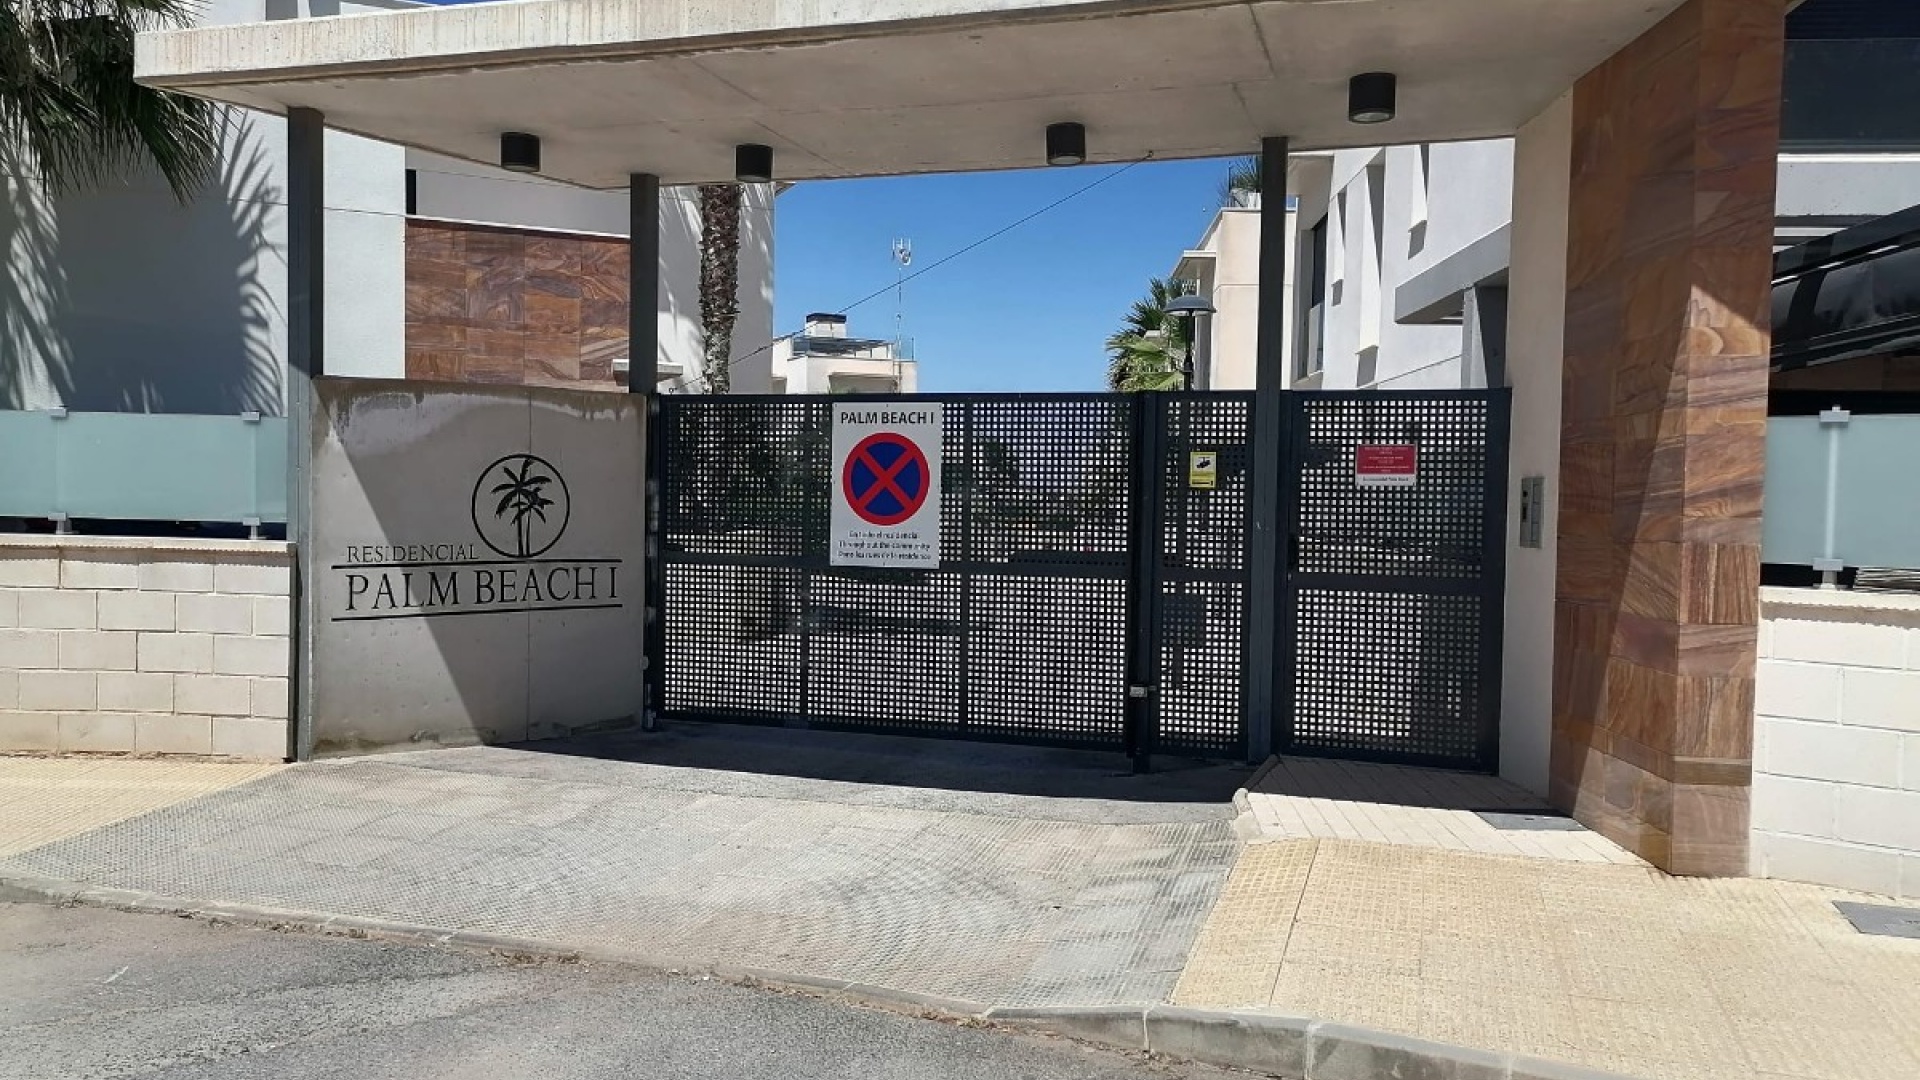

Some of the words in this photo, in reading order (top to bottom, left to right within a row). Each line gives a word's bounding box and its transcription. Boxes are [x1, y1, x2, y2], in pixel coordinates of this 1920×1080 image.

[841, 411, 878, 424] PALM
[881, 411, 927, 424] BEACH
[931, 411, 934, 424] I
[346, 544, 480, 562] RESIDENCIAL
[345, 570, 460, 611] PALM
[473, 567, 598, 605] BEACH
[608, 566, 617, 598] I
